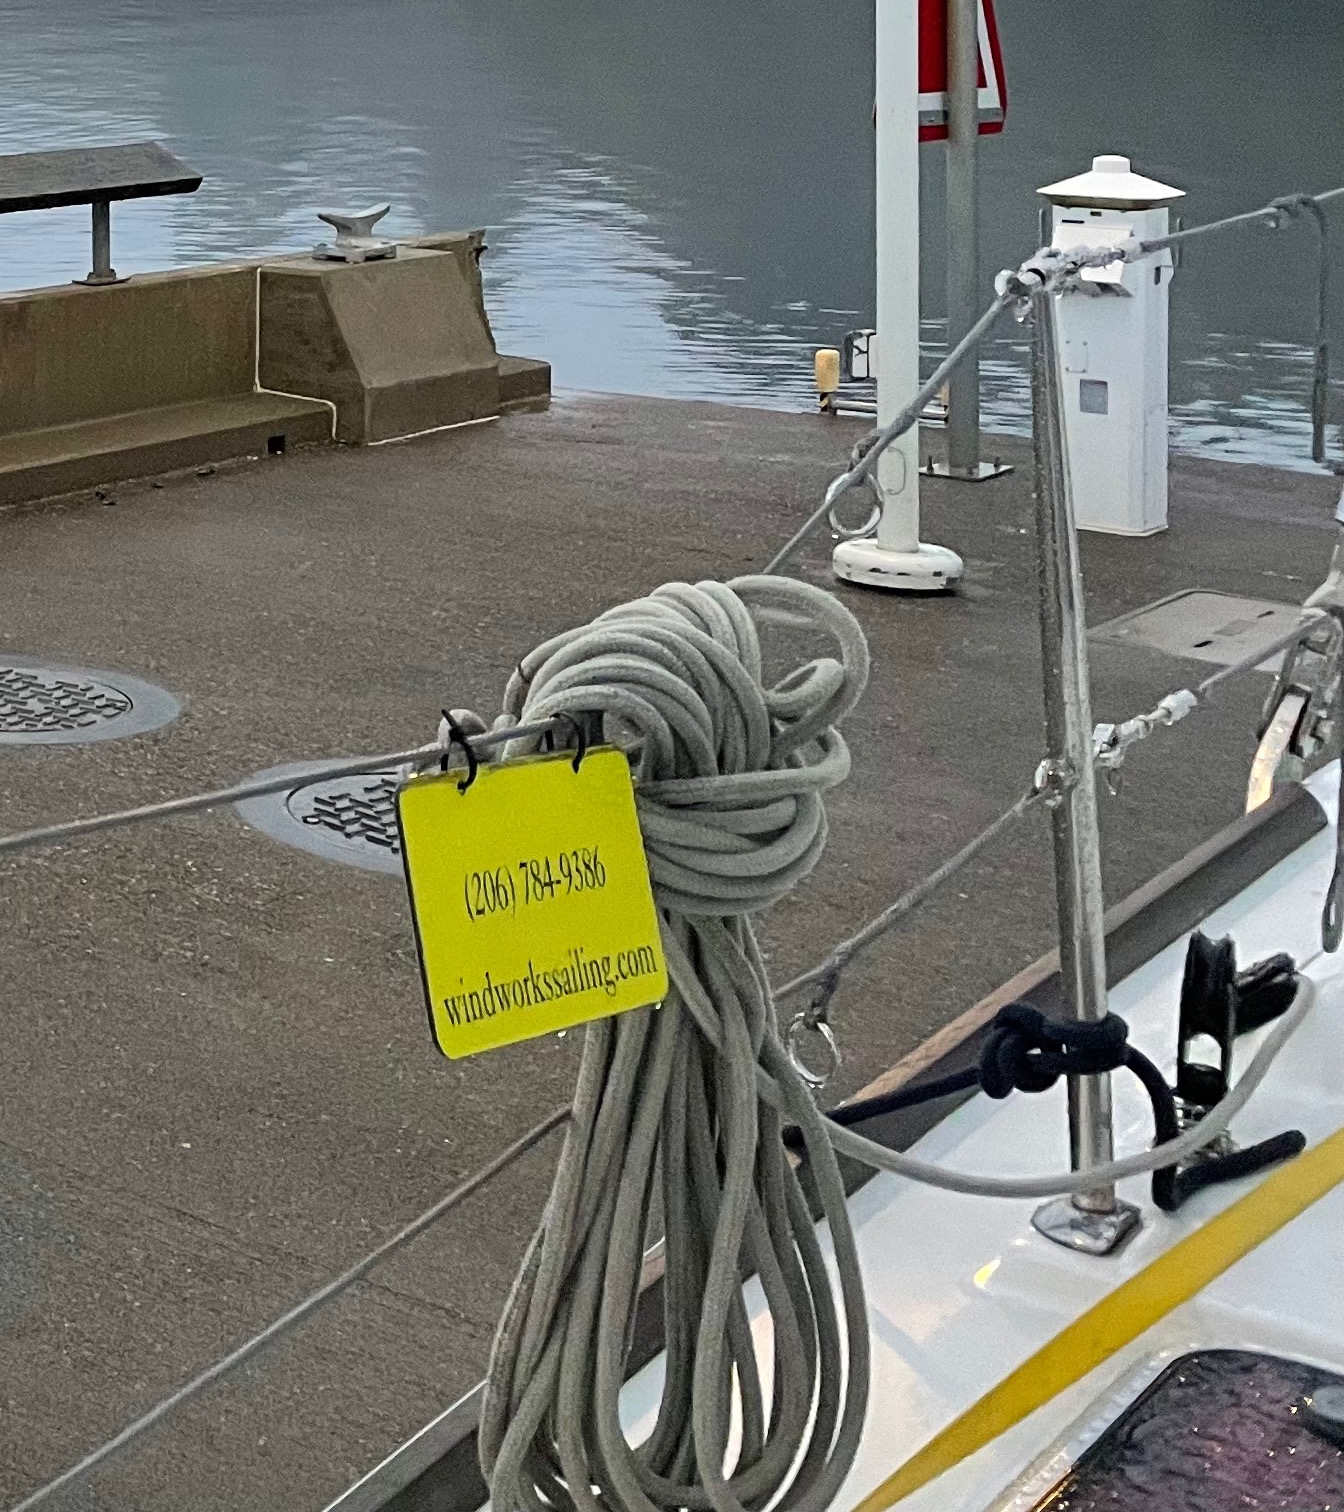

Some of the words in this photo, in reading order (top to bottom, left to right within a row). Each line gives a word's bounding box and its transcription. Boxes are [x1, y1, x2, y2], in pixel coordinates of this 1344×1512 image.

[464, 864, 516, 921] (206)
[519, 845, 606, 905] 784-9386
[443, 945, 658, 1026] windworkssailing.com
